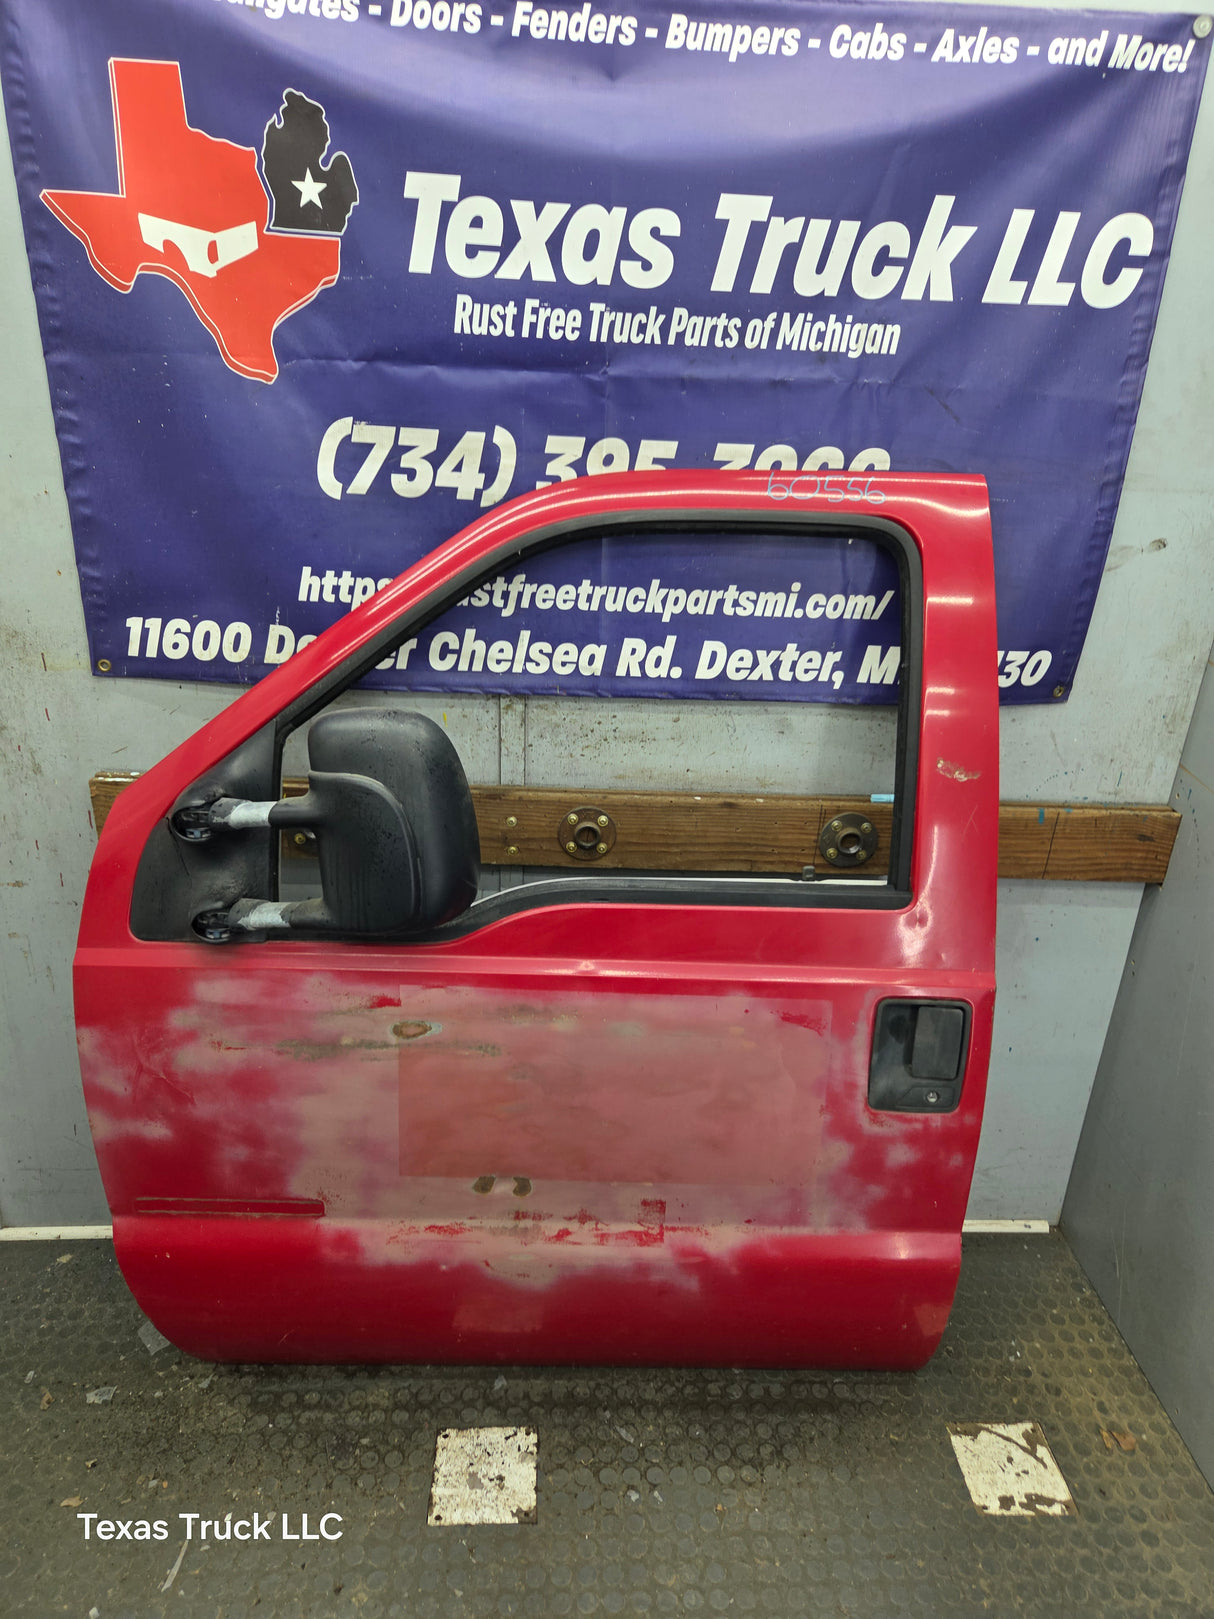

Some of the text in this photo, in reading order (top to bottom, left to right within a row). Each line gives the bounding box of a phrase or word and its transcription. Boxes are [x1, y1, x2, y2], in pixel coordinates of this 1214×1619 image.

[390, 0, 482, 33] Doors
[511, 1, 638, 46] Fenders
[665, 13, 801, 62] Bumpers
[829, 23, 907, 61] Cabs
[931, 27, 1019, 64] Axles
[1047, 31, 1107, 67] and
[1108, 34, 1196, 74] More!
[404, 171, 1154, 309] Texas Truck LLC
[454, 294, 901, 359] Rust Free Truck Parts of Michigan
[317, 416, 517, 508] (734)
[767, 472, 886, 505] 60556
[126, 617, 252, 662] 11600
[429, 629, 607, 676] Chelsea
[616, 635, 682, 679] Rd.
[695, 640, 844, 689] Dexter,
[857, 645, 900, 685] M
